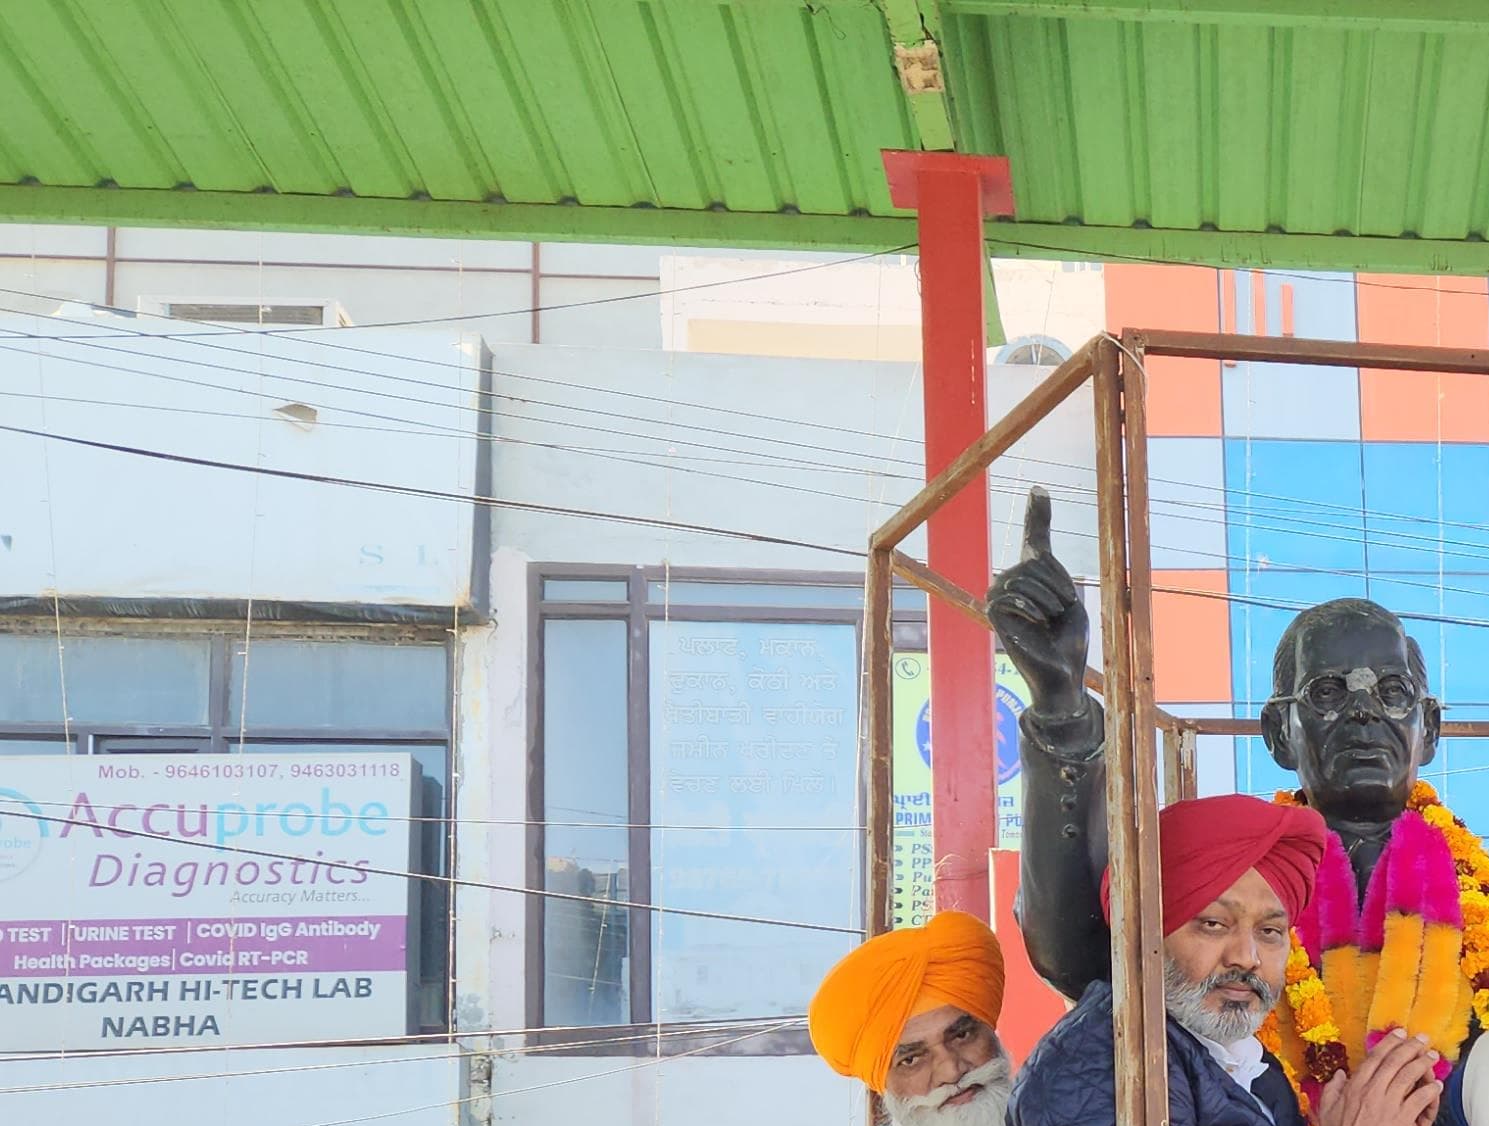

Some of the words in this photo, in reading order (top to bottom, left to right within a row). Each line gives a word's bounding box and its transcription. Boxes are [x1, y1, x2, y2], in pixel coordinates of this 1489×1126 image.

[98, 764, 145, 779] Mob.
[165, 763, 284, 779] 9646103107,
[290, 763, 400, 778] 9463031118
[59, 787, 389, 852] Accuprobe
[88, 851, 370, 897] Diagnostics
[230, 891, 296, 905] Accuracy
[7, 928, 51, 942] TEST
[74, 926, 129, 941] URINE
[132, 926, 176, 941] TEST
[197, 923, 257, 938] COVID
[260, 923, 294, 940] IgG
[295, 921, 381, 939] Antibody
[14, 954, 75, 969] Health
[80, 953, 170, 972] Packages
[180, 950, 234, 967] Covid
[239, 950, 308, 965] RT-PCR
[180, 979, 302, 1001] HI-TECH
[312, 977, 373, 998] LAB
[101, 1015, 220, 1038] NABHA
